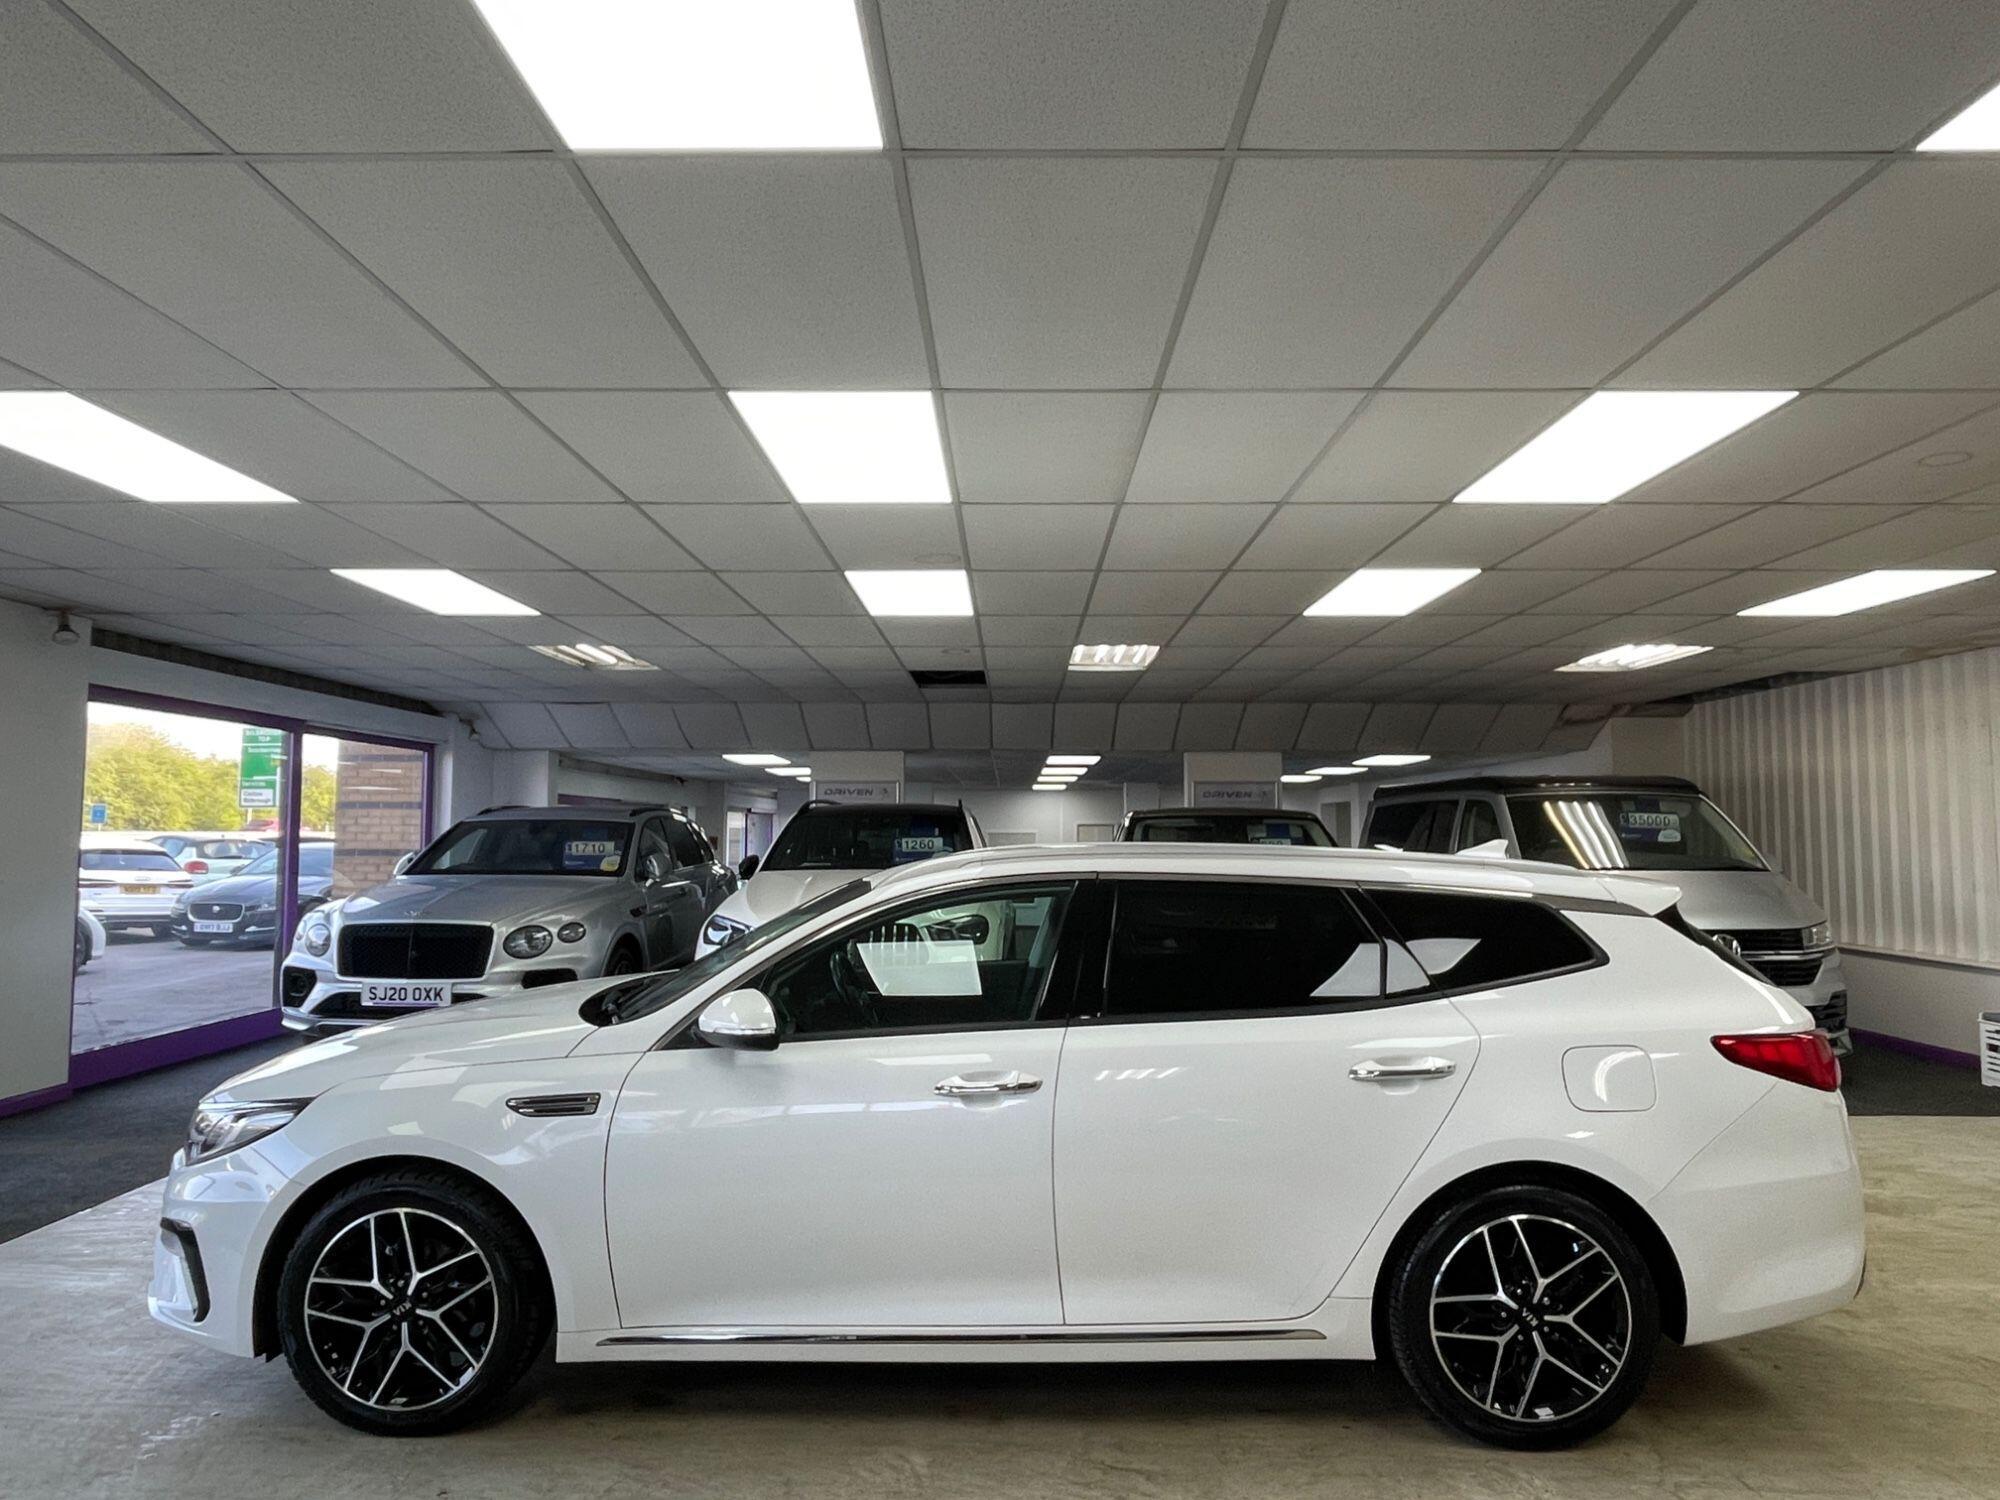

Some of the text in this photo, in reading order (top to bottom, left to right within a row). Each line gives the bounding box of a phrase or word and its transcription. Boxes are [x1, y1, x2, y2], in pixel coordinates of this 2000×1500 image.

[824, 788, 874, 796] DRIVEN
[1202, 790, 1253, 798] DRIVEN
[368, 986, 408, 1001] SJ20
